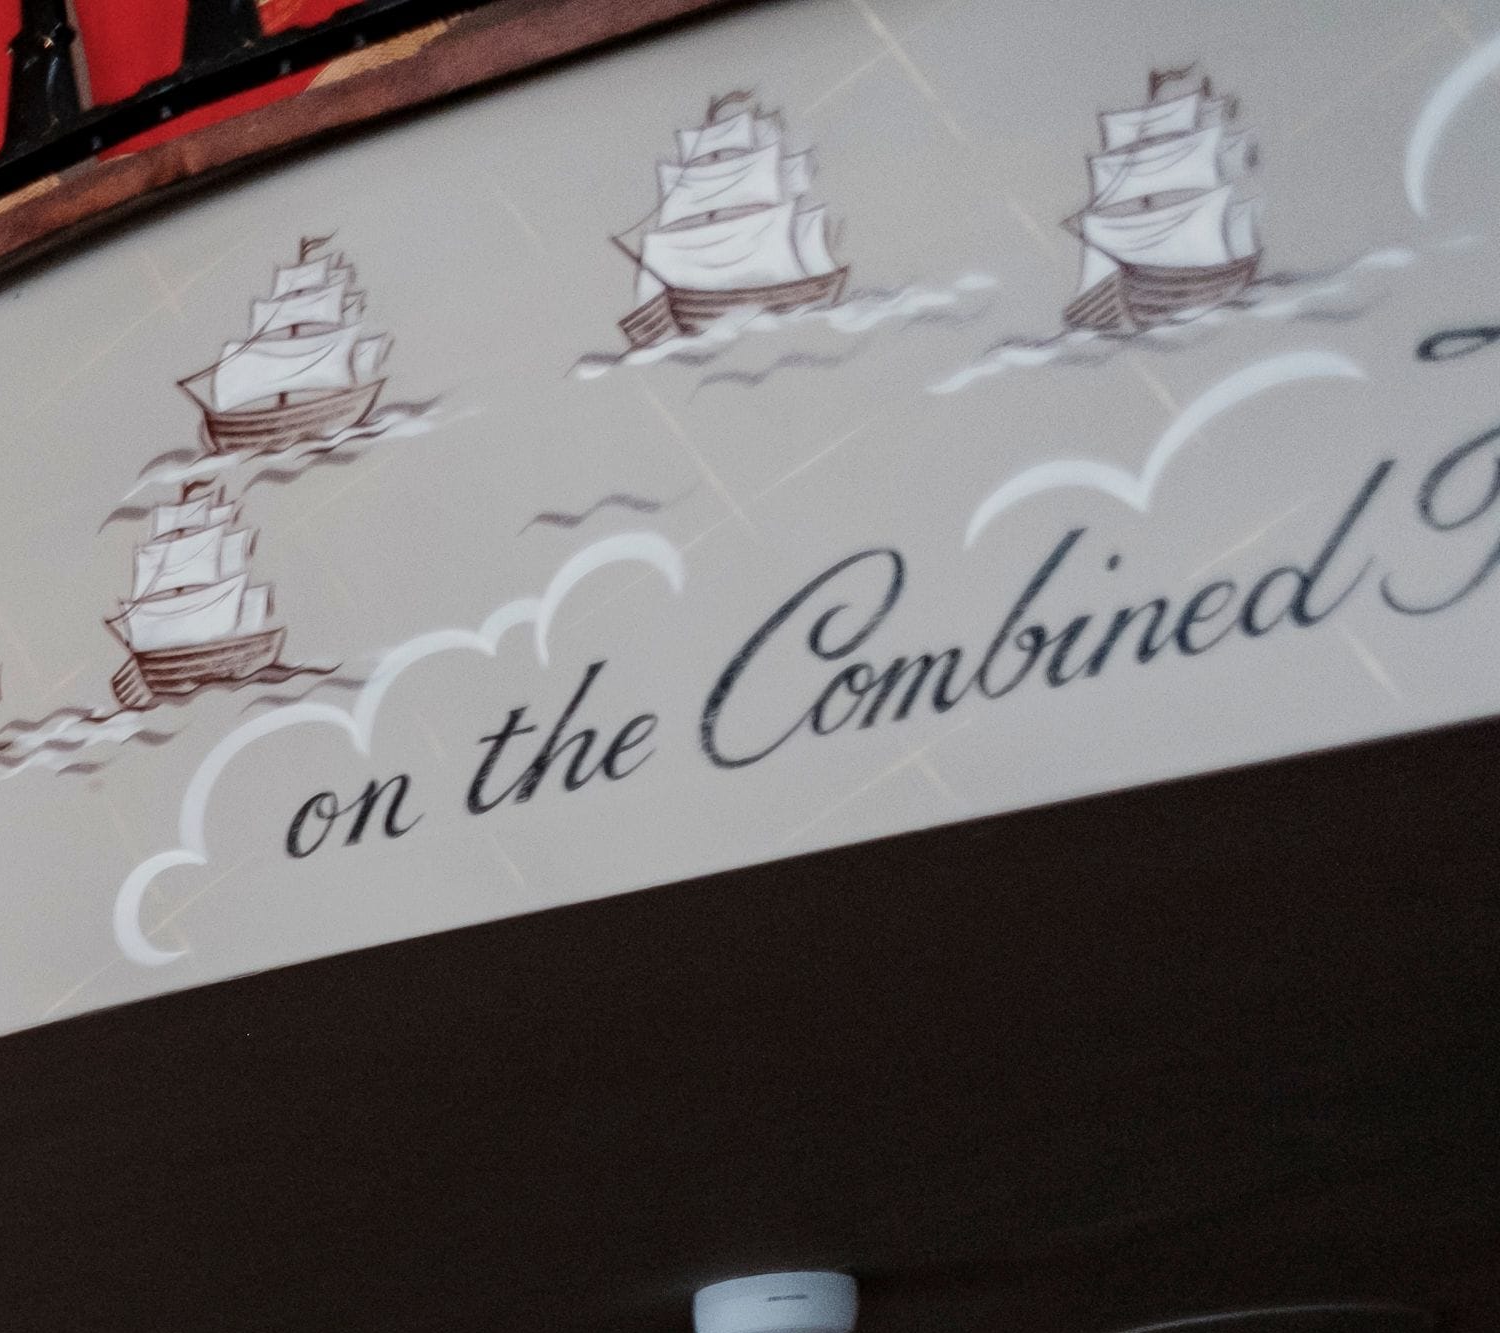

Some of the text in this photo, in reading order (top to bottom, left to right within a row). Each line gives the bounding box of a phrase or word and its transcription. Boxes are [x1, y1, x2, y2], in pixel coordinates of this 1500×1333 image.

[283, 773, 426, 860] on
[464, 660, 659, 817] the
[699, 457, 1398, 772] Combined
